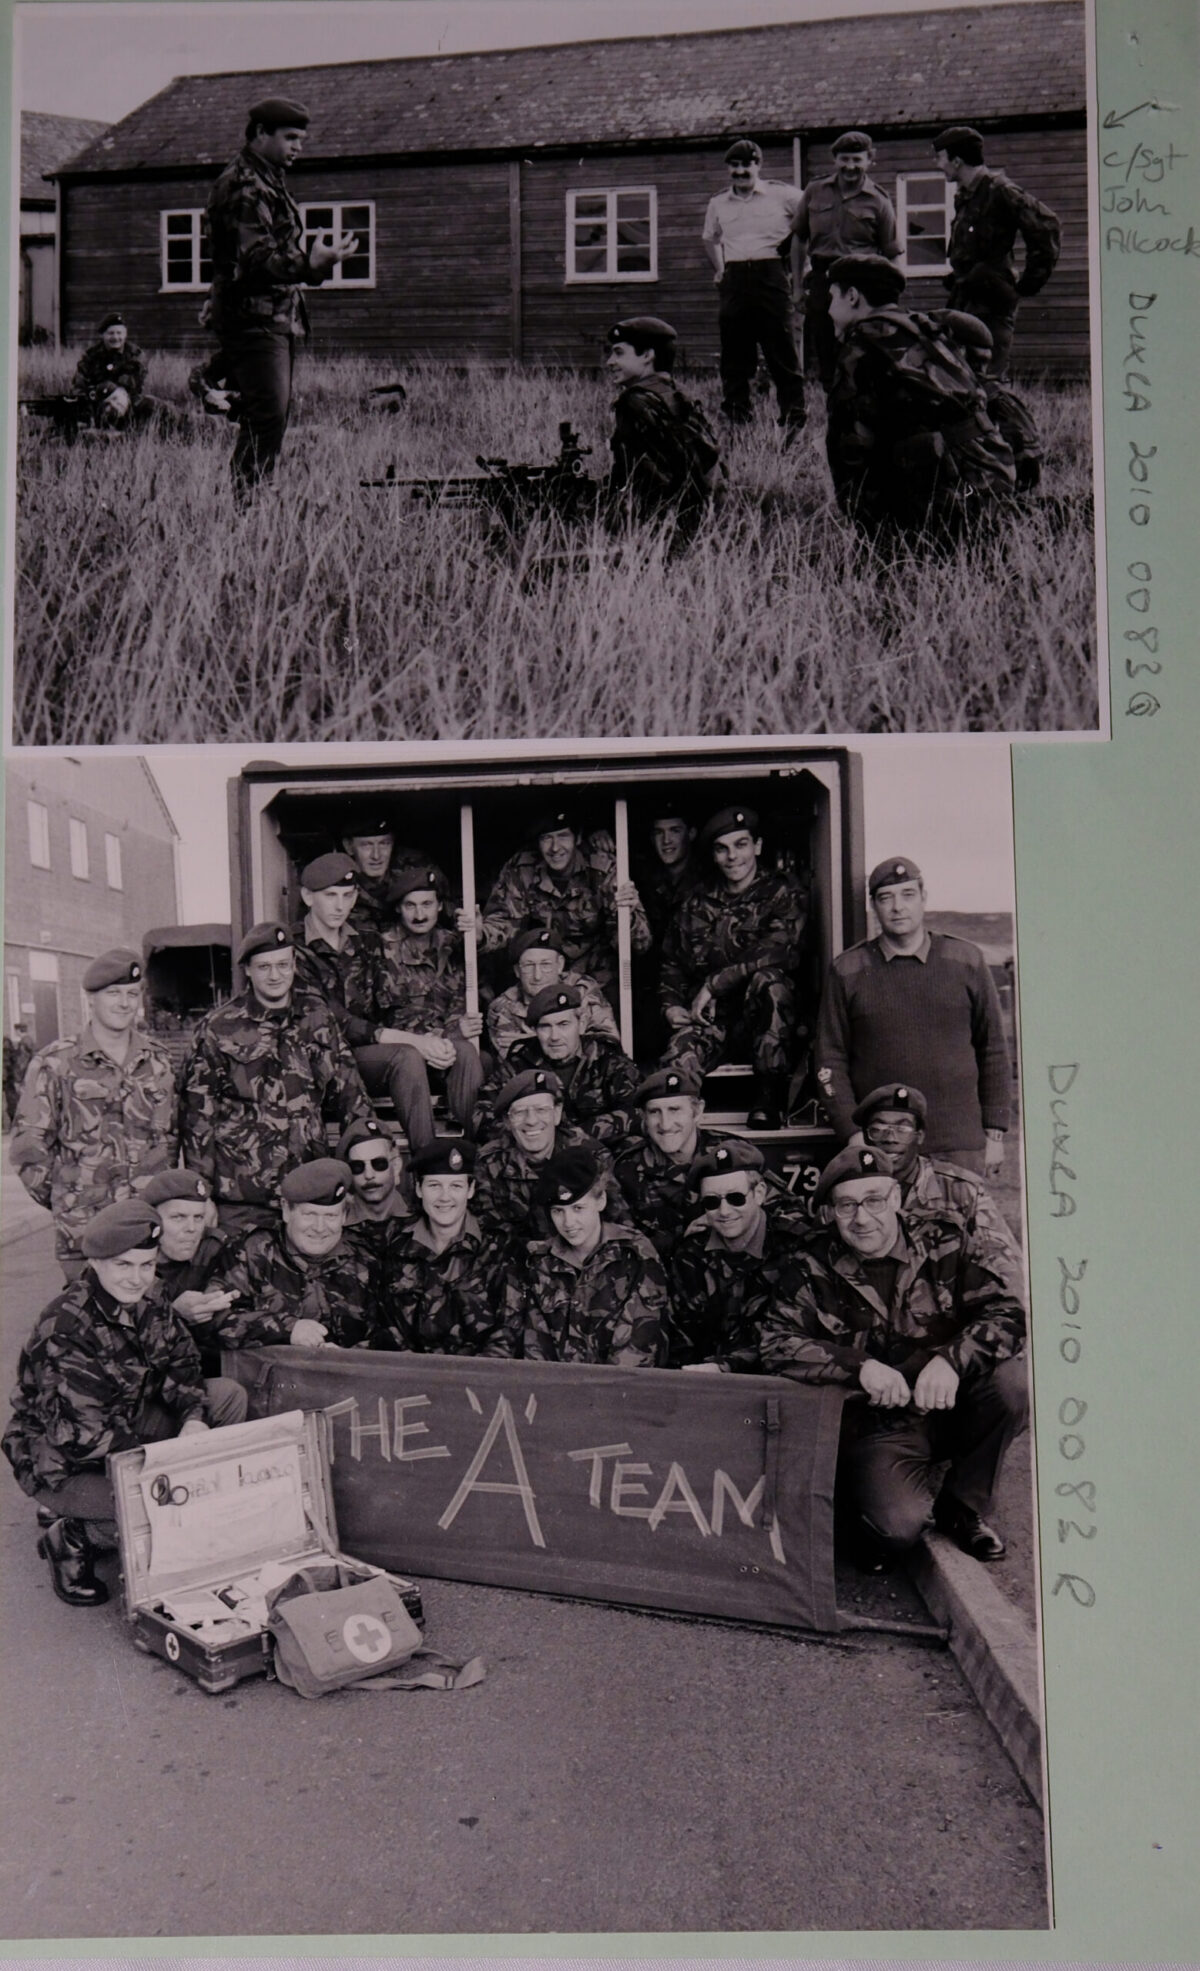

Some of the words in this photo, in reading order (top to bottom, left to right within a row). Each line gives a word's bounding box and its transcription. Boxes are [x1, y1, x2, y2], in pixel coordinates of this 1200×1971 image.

[1102, 186, 1171, 216] John
[1106, 227, 1200, 257] Allcock
[1129, 441, 1158, 526] 2010
[782, 1164, 821, 1192] 73
[1056, 1256, 1088, 1364] 2010
[323, 1394, 452, 1466] THE
[566, 1442, 787, 1565] TEAM
